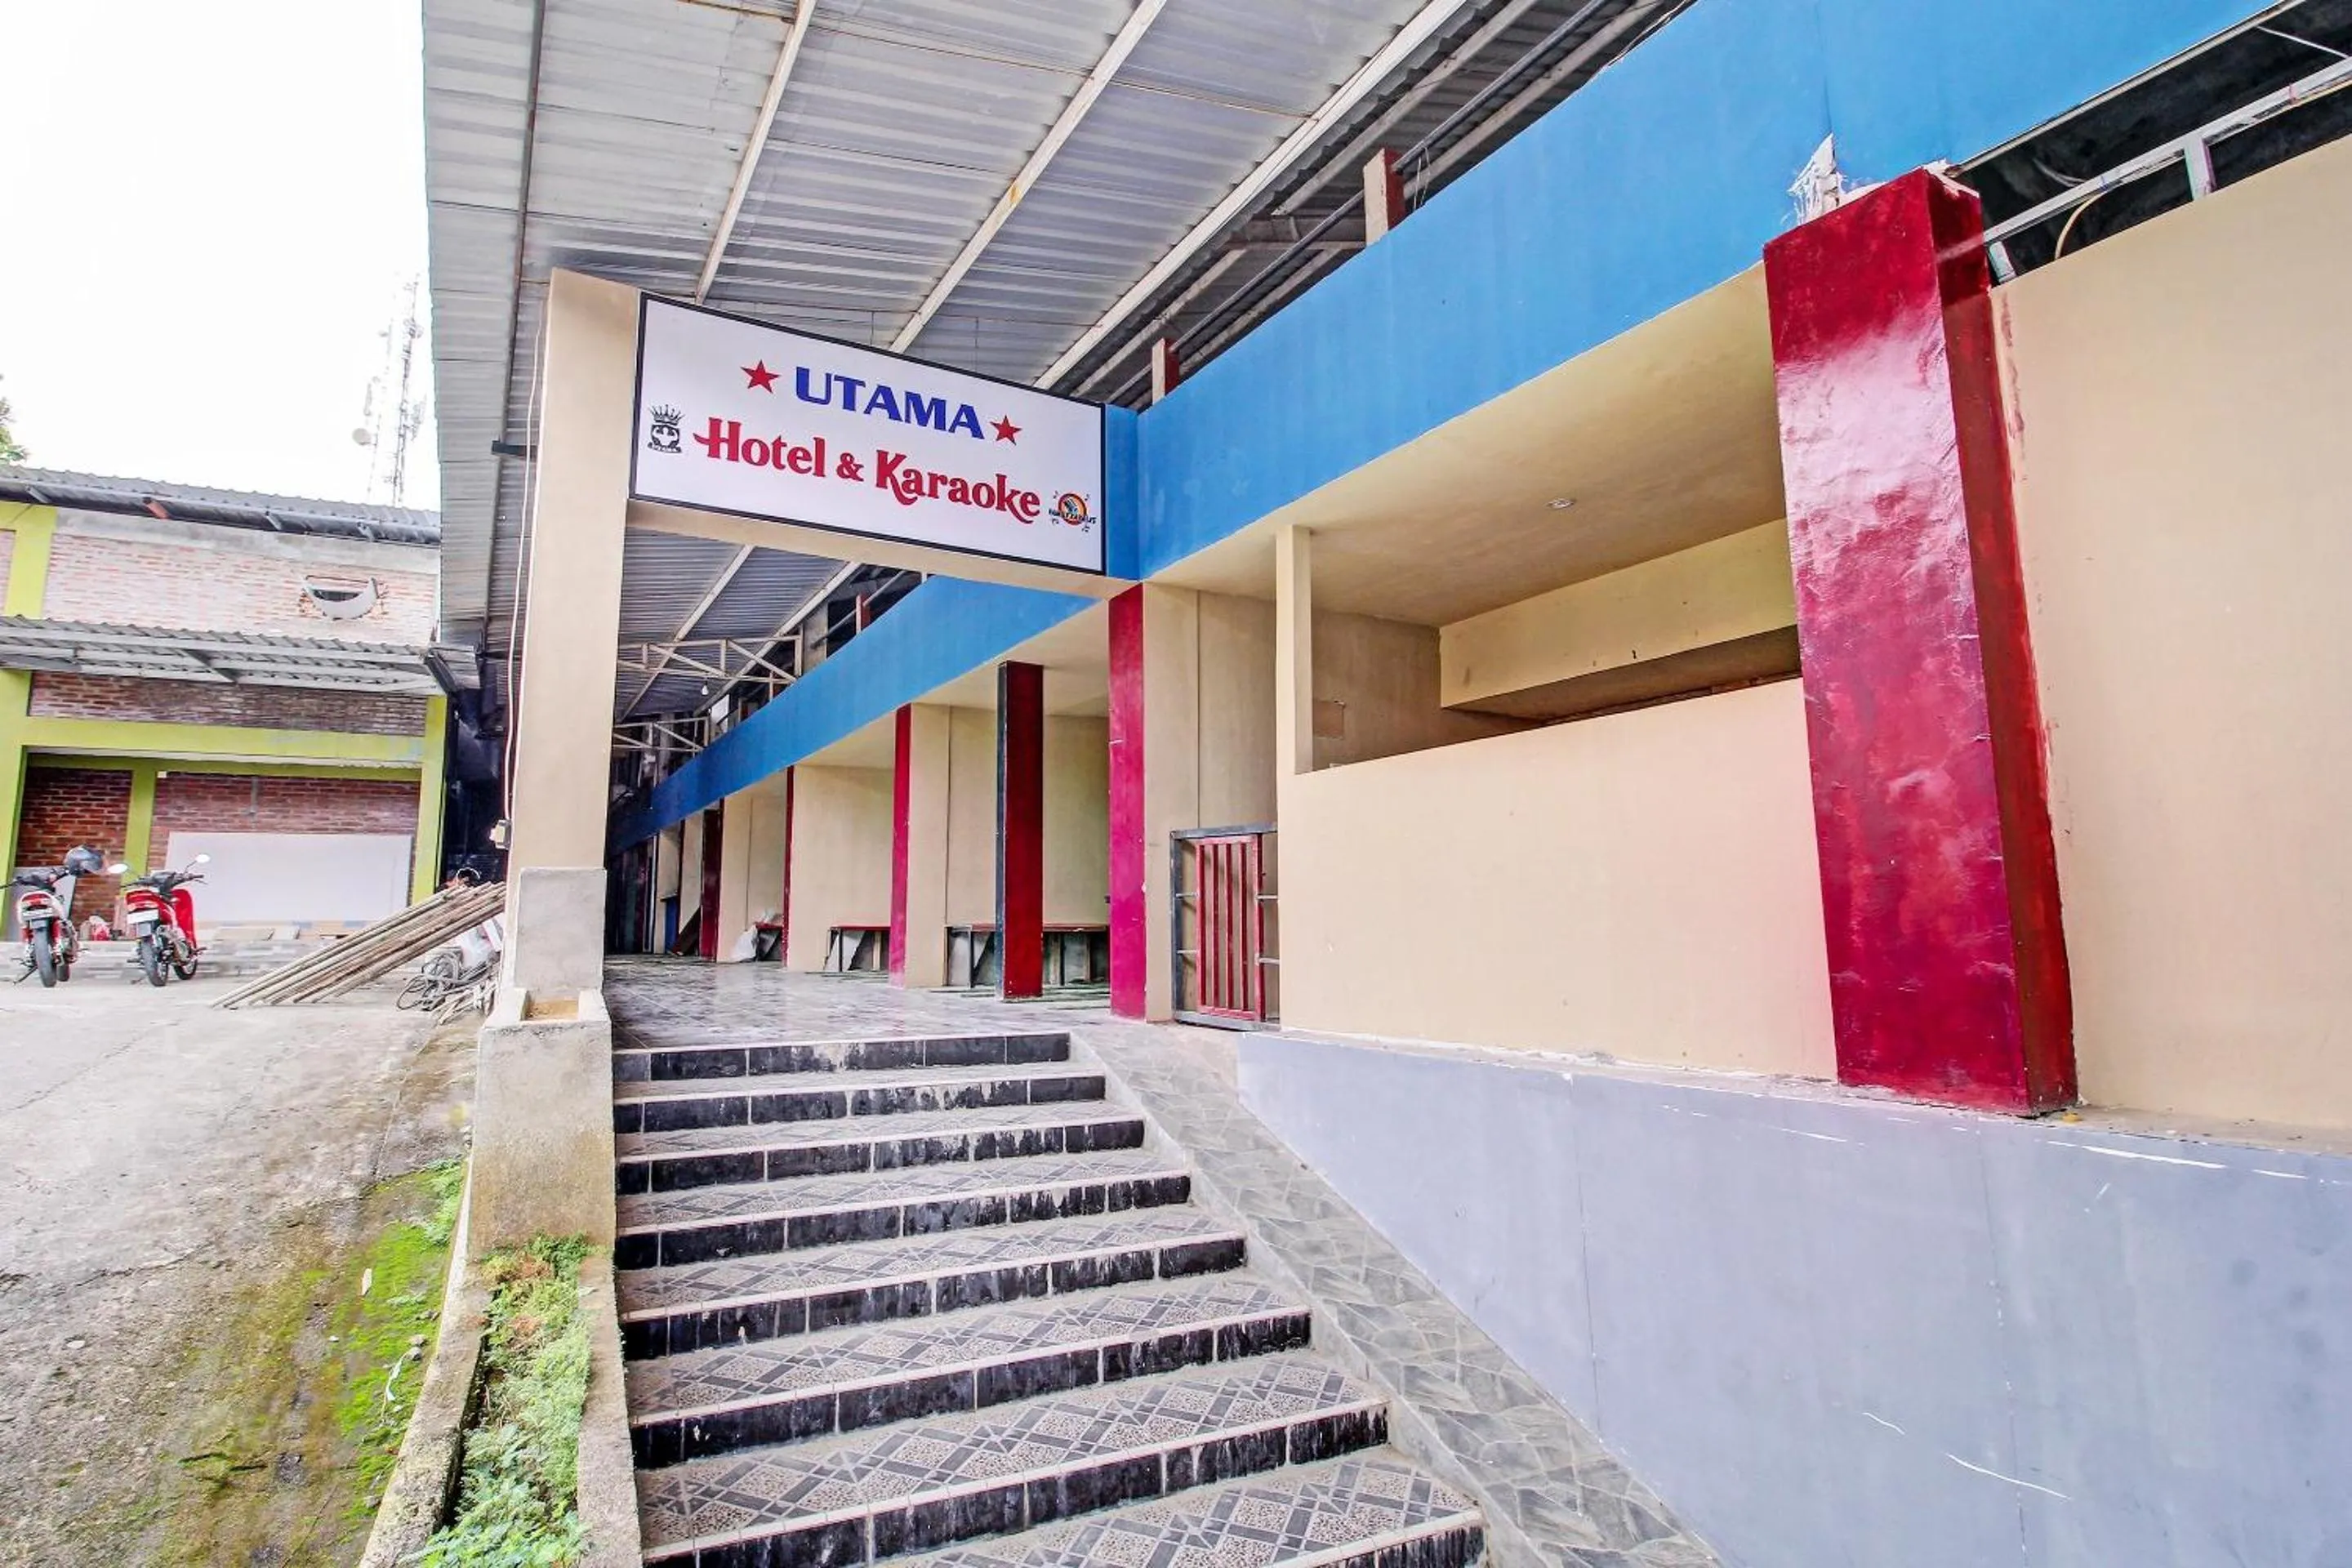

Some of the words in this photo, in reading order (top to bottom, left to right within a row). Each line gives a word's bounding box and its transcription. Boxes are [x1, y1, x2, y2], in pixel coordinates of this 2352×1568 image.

[795, 366, 985, 440] UTAMA
[693, 416, 826, 478] Hotel
[835, 451, 865, 482] &
[875, 449, 1041, 524] Karaoke
